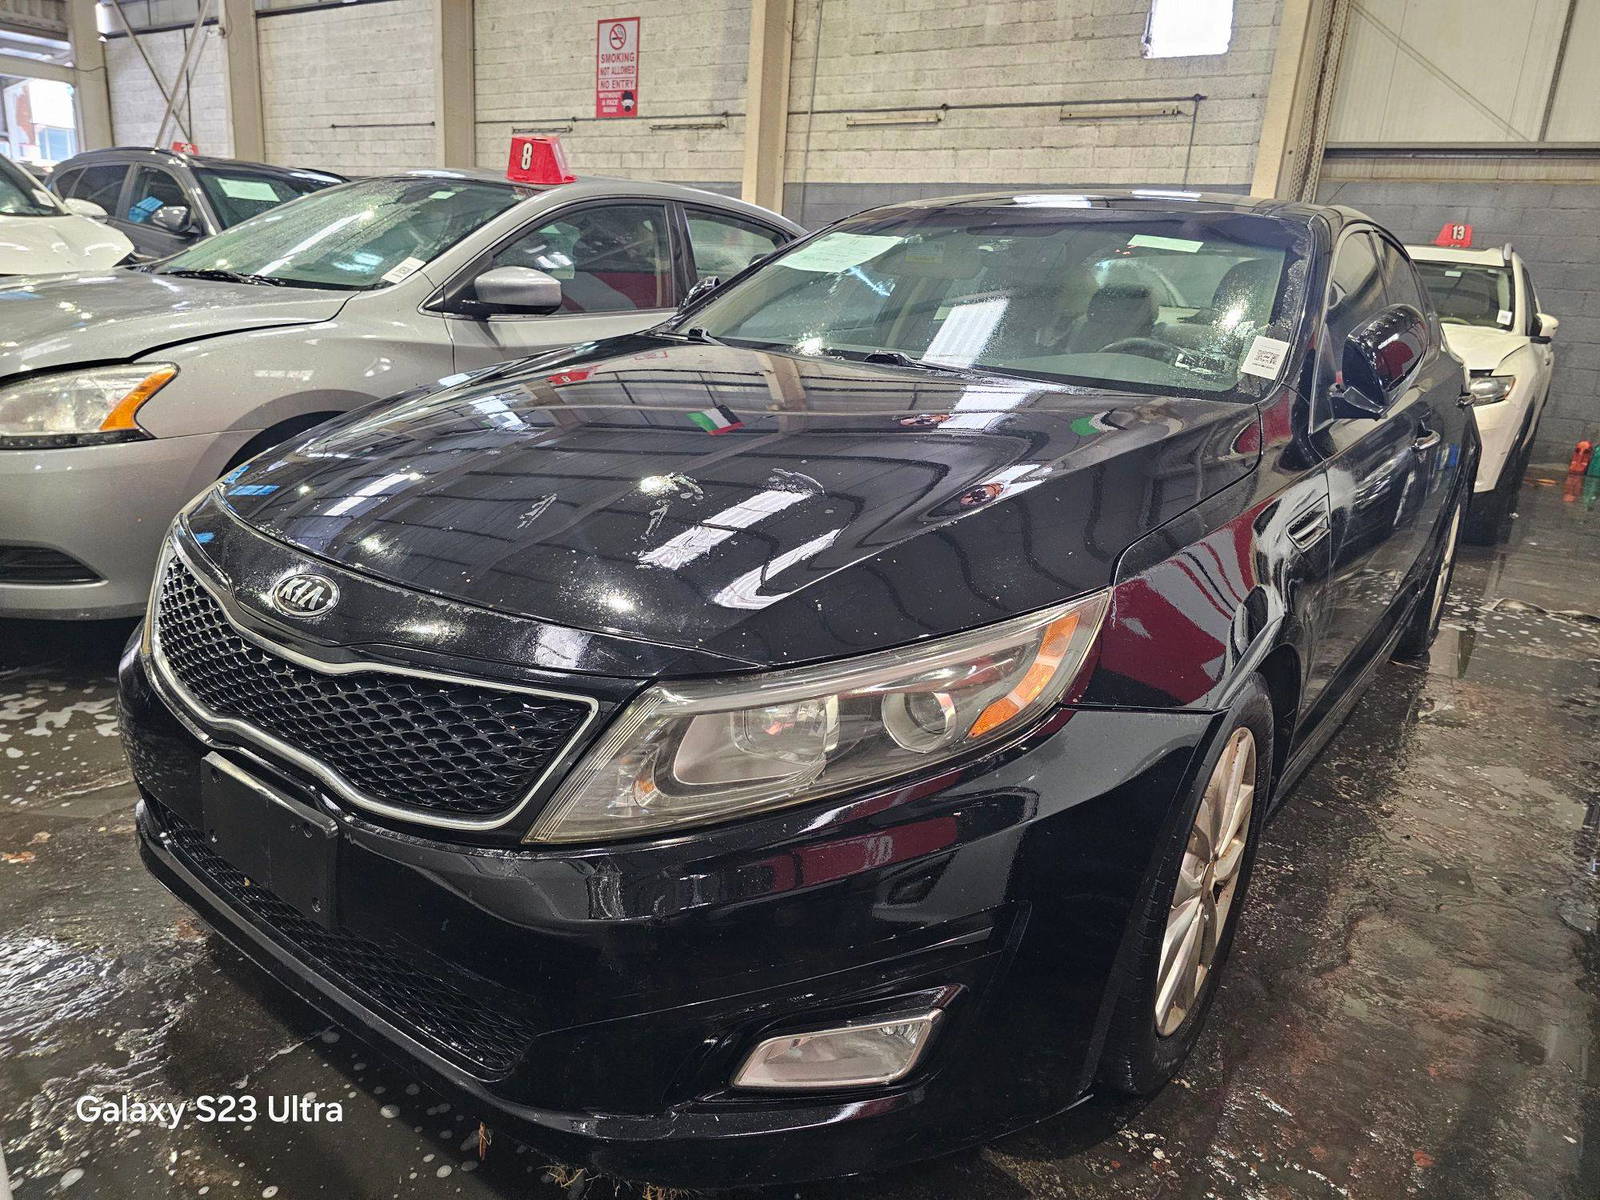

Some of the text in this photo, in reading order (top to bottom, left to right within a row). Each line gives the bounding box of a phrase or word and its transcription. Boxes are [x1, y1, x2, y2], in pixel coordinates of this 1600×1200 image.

[600, 52, 635, 64] SMOKING
[600, 65, 635, 75] NOT ALLOWED
[600, 80, 634, 89] NO ENTRY
[521, 142, 533, 171] 8
[1452, 225, 1466, 240] 13
[279, 577, 325, 611] KIA
